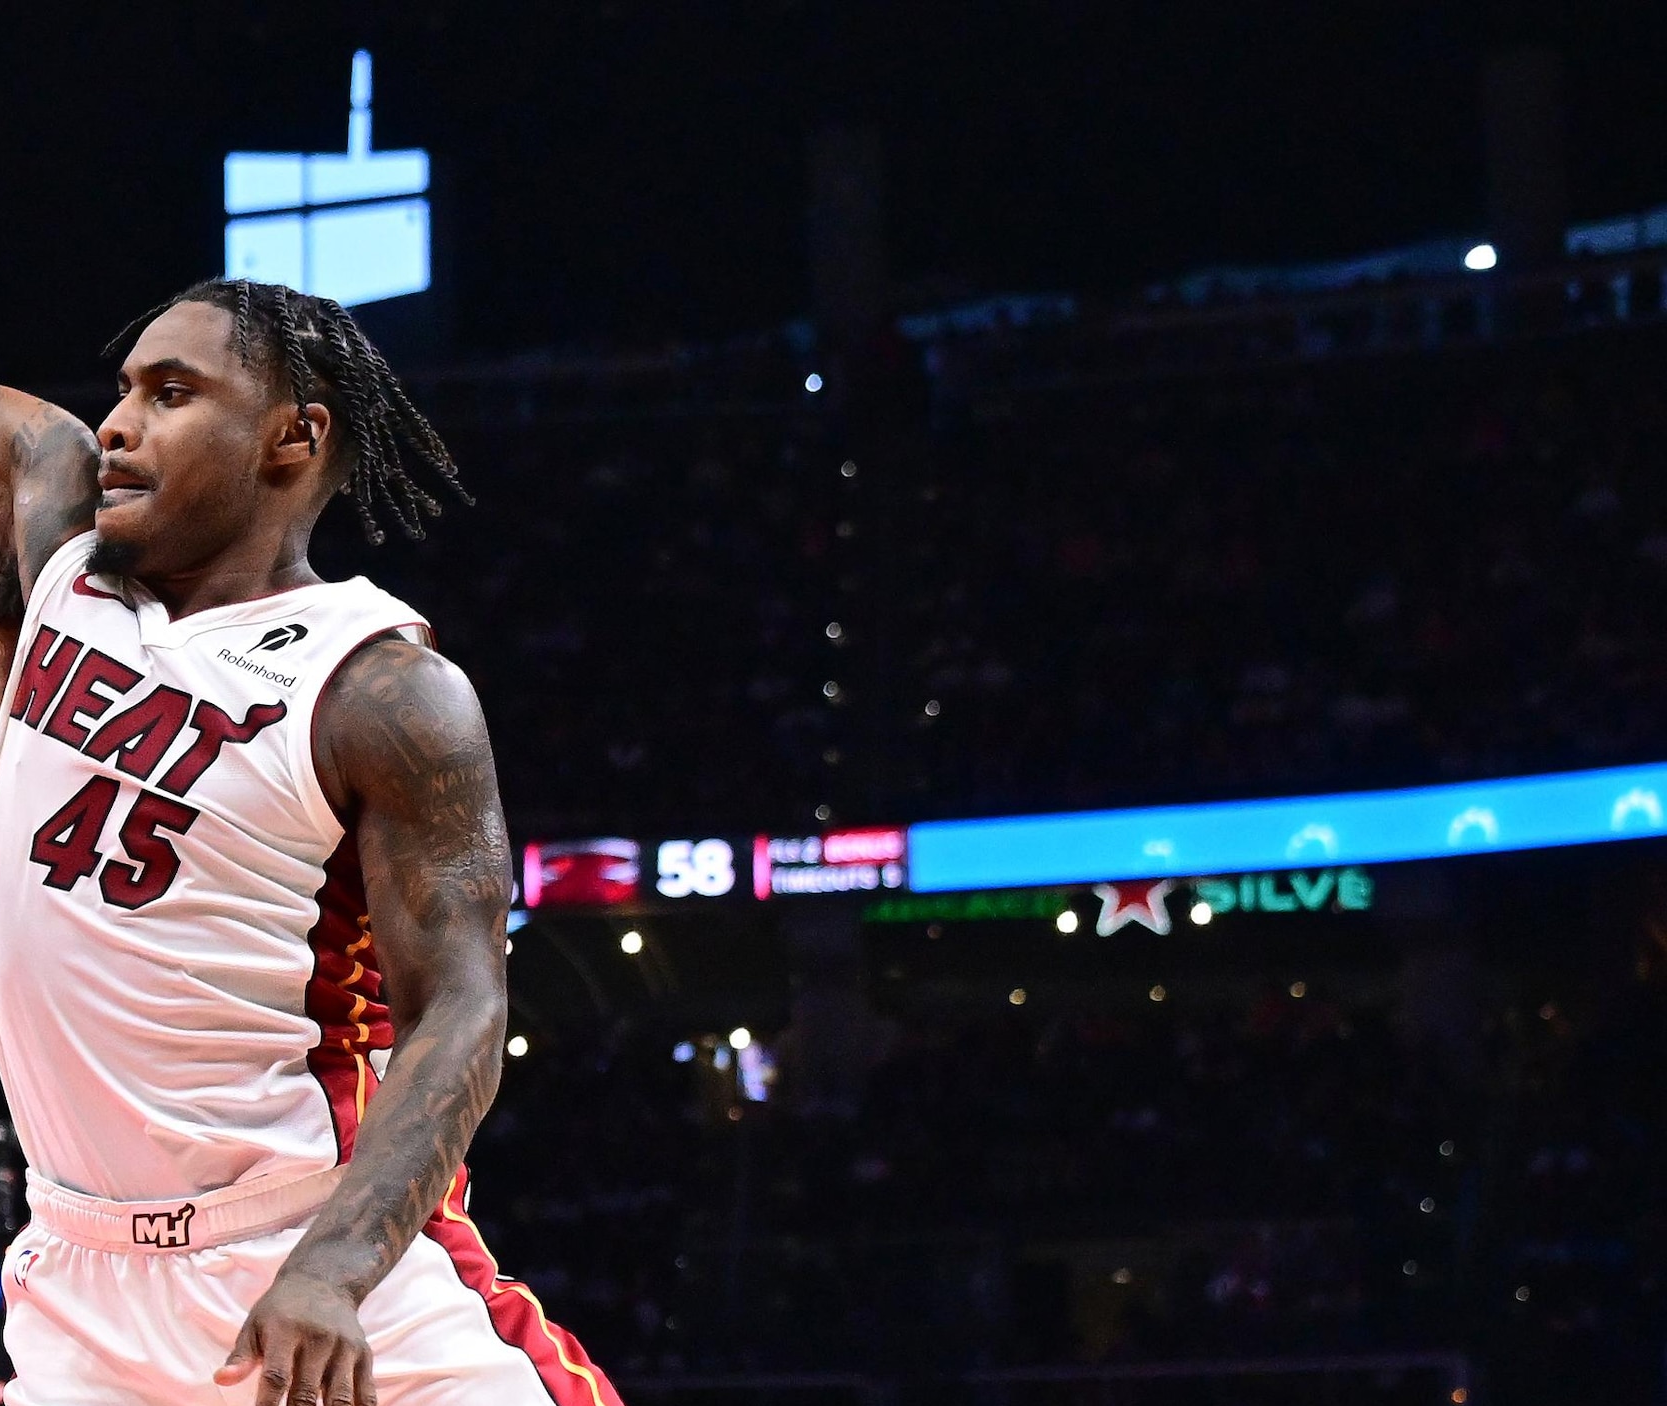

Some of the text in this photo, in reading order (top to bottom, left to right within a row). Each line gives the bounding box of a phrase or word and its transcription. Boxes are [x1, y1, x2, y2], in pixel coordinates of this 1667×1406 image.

[9, 623, 288, 798] HEAT
[216, 648, 297, 689] Robinhood
[29, 774, 201, 910] 45
[655, 837, 737, 898] 58
